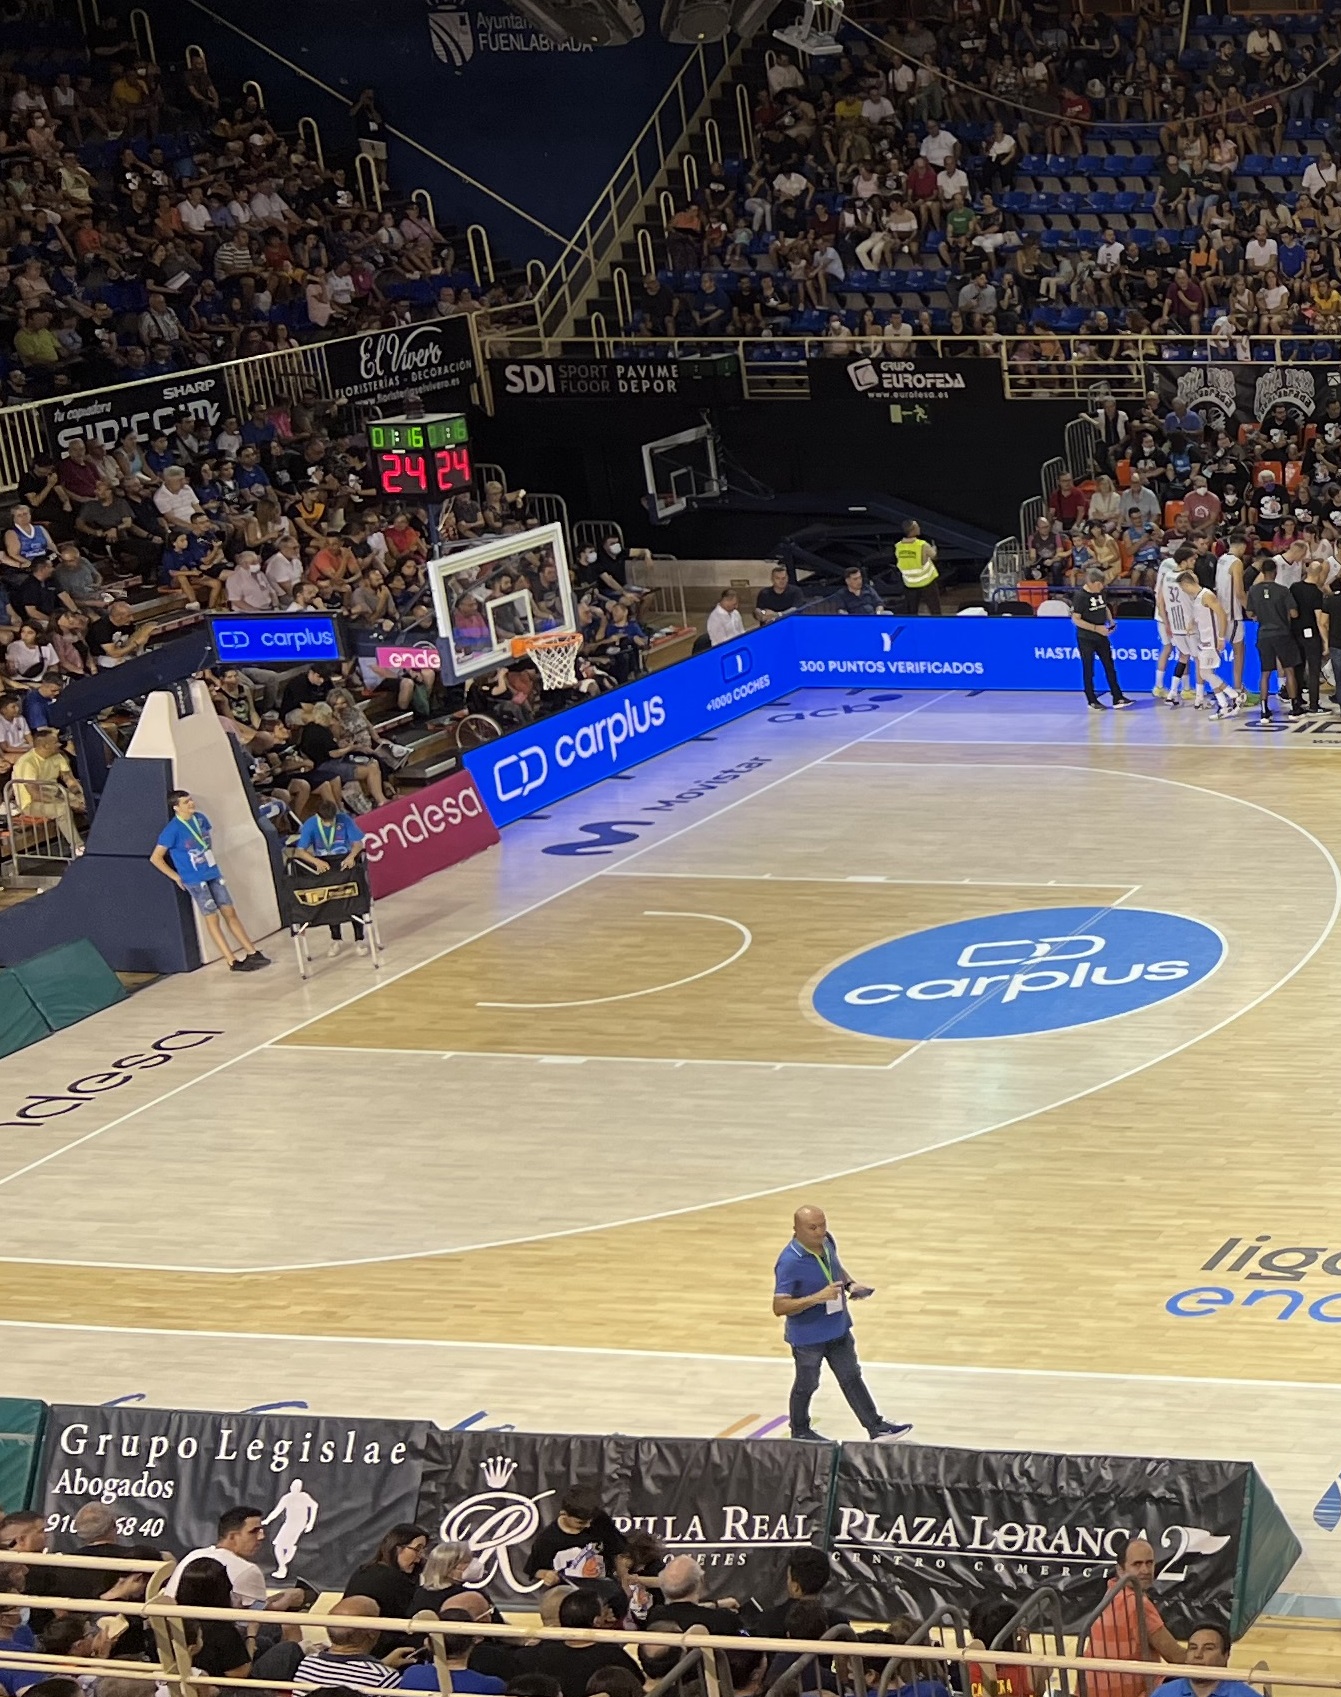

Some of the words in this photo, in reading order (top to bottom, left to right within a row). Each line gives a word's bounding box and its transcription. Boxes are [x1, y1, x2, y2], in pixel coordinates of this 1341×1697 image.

[360, 334, 386, 379] El
[387, 326, 442, 372] Vivero
[881, 362, 915, 371] GRUPO
[335, 375, 400, 399] FLORISTERÍAS
[411, 359, 472, 381] DECORACIÓN
[505, 364, 555, 394] SDI
[558, 365, 609, 379] SPORT
[560, 379, 610, 394] FLOOR
[882, 373, 966, 388] EUROFESA
[163, 379, 216, 400] SHARP
[371, 427, 424, 448] 01:16
[382, 454, 428, 493] 24
[435, 449, 471, 491] 24
[1169, 587, 1180, 603] 32
[261, 625, 334, 651] carplus
[799, 661, 826, 673] 300
[828, 660, 870, 674] PUNTOS
[871, 661, 984, 675] VERIFICADOS
[1034, 647, 1082, 660] HASTA
[706, 692, 733, 711] +1000
[733, 674, 771, 700] COCHES
[766, 701, 881, 724] acb
[556, 695, 666, 762] carplus
[642, 755, 775, 812] Movistar
[364, 785, 481, 863] endesa
[844, 960, 1190, 1005] carplus
[60, 1423, 198, 1468] Grupo
[216, 1429, 407, 1473] Legislae
[52, 1468, 175, 1504] Abogados
[139, 1517, 165, 1538] 40
[721, 1504, 813, 1542] REAL
[835, 1505, 962, 1547] PLAZA
[1157, 1525, 1189, 1582] 2
[831, 1550, 946, 1569] CENTRO
